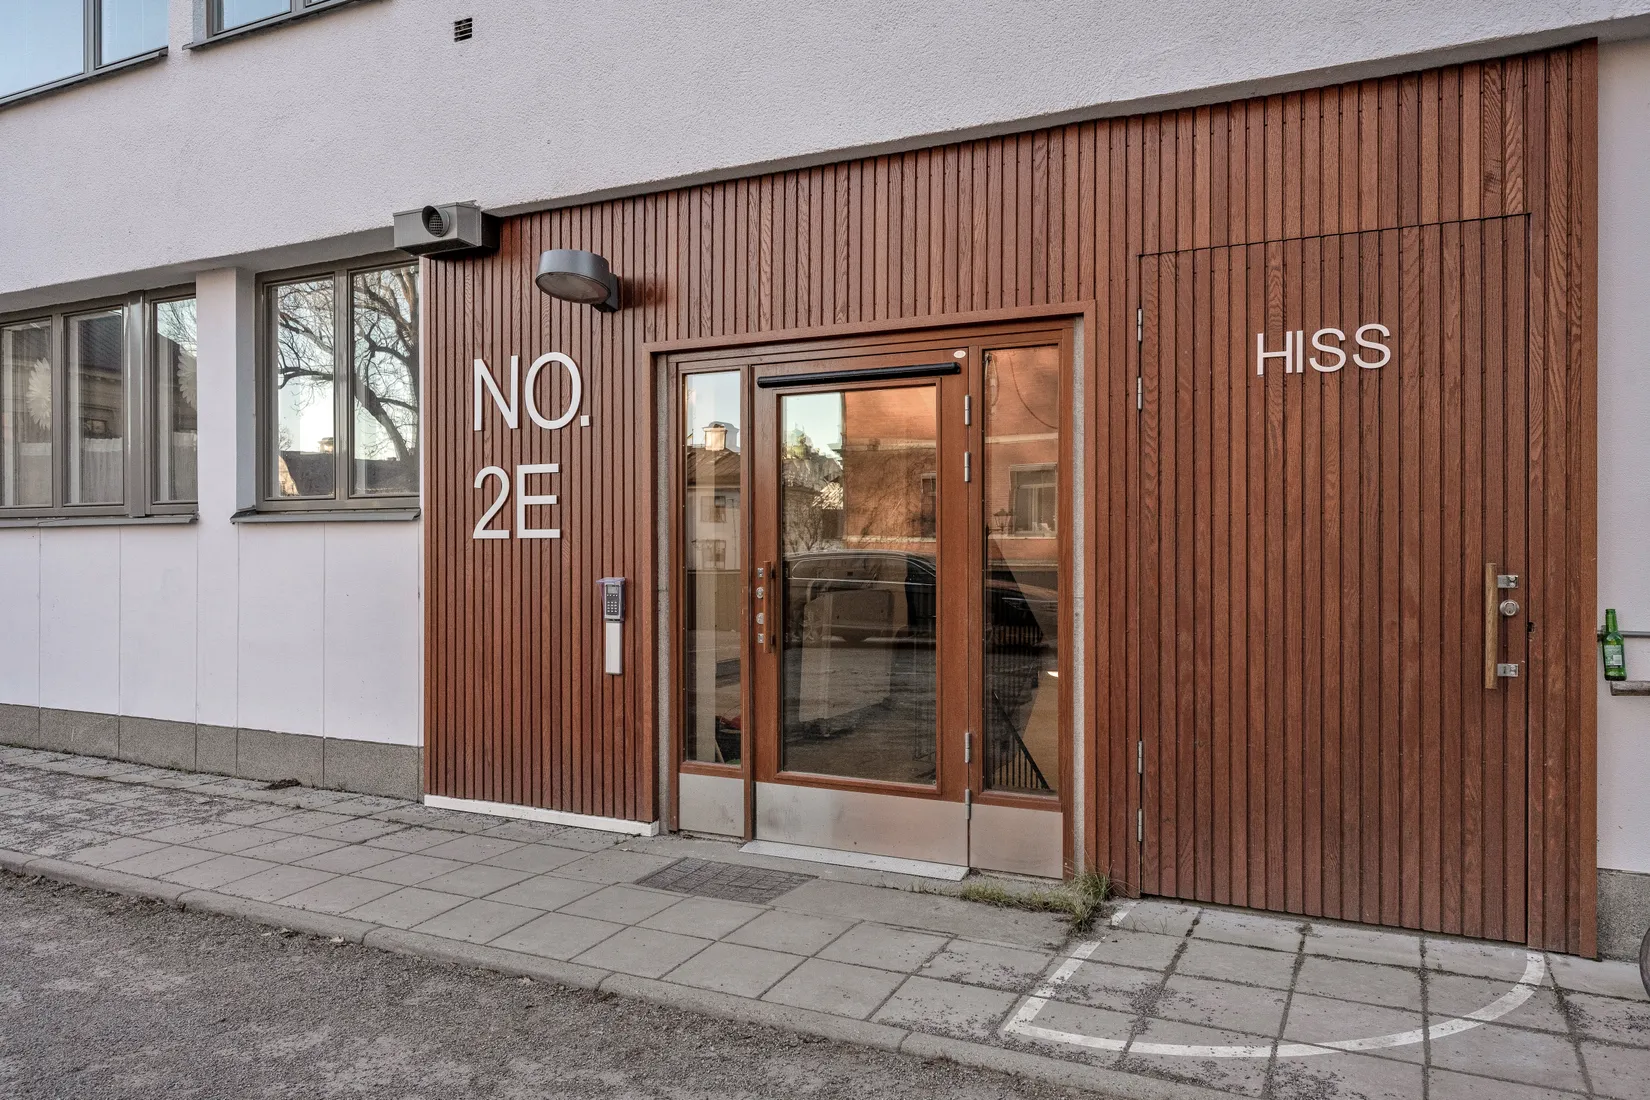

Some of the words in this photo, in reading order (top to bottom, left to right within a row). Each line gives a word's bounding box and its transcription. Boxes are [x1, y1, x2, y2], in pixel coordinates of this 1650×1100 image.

[1257, 323, 1391, 376] HISS
[473, 351, 590, 431] NO.
[472, 463, 561, 539] 2E
